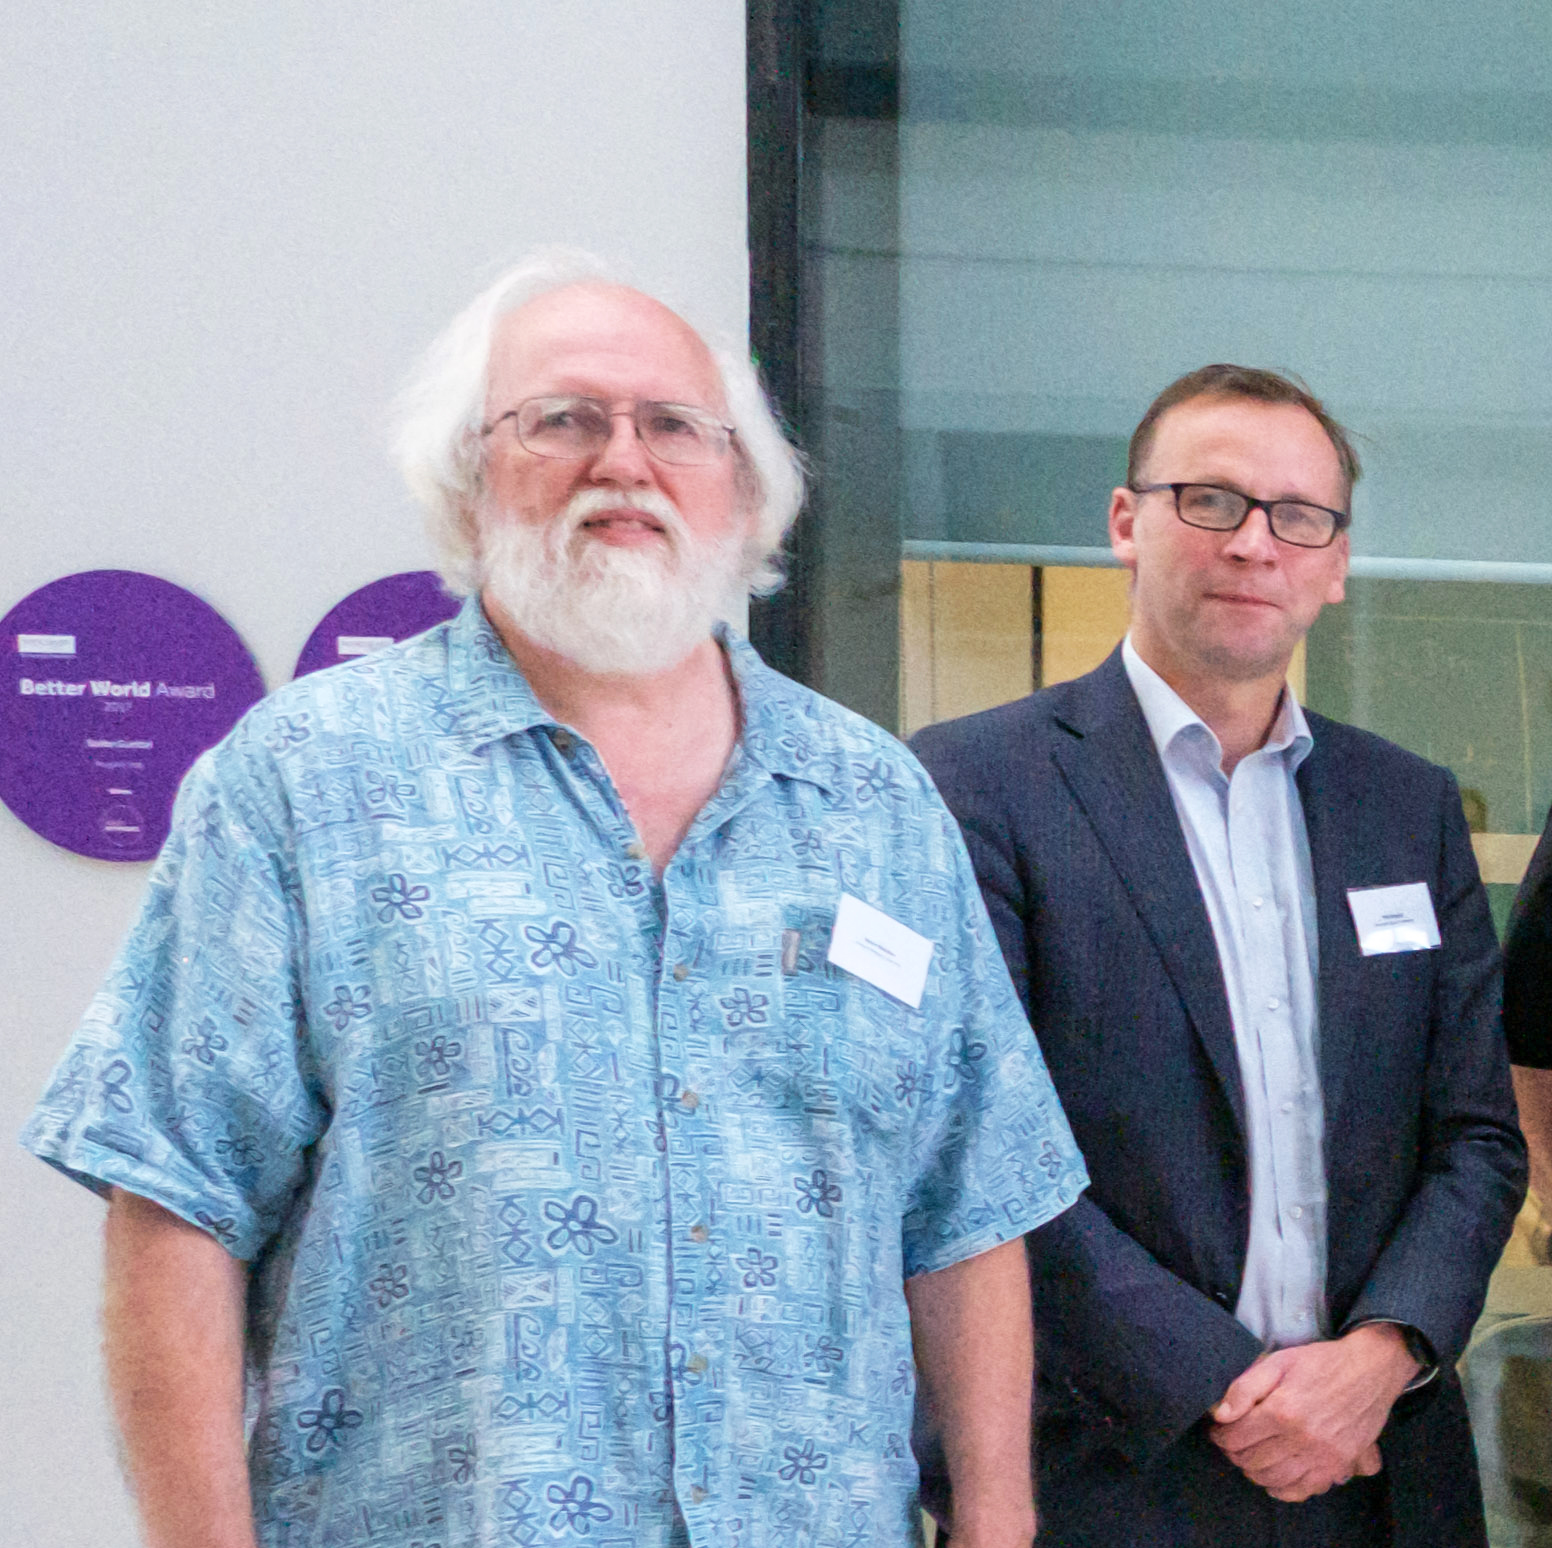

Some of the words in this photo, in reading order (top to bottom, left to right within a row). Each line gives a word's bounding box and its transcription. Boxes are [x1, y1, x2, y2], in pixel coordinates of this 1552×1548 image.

[19, 677, 87, 697] Better
[89, 680, 151, 698] World
[156, 682, 216, 699] Award
